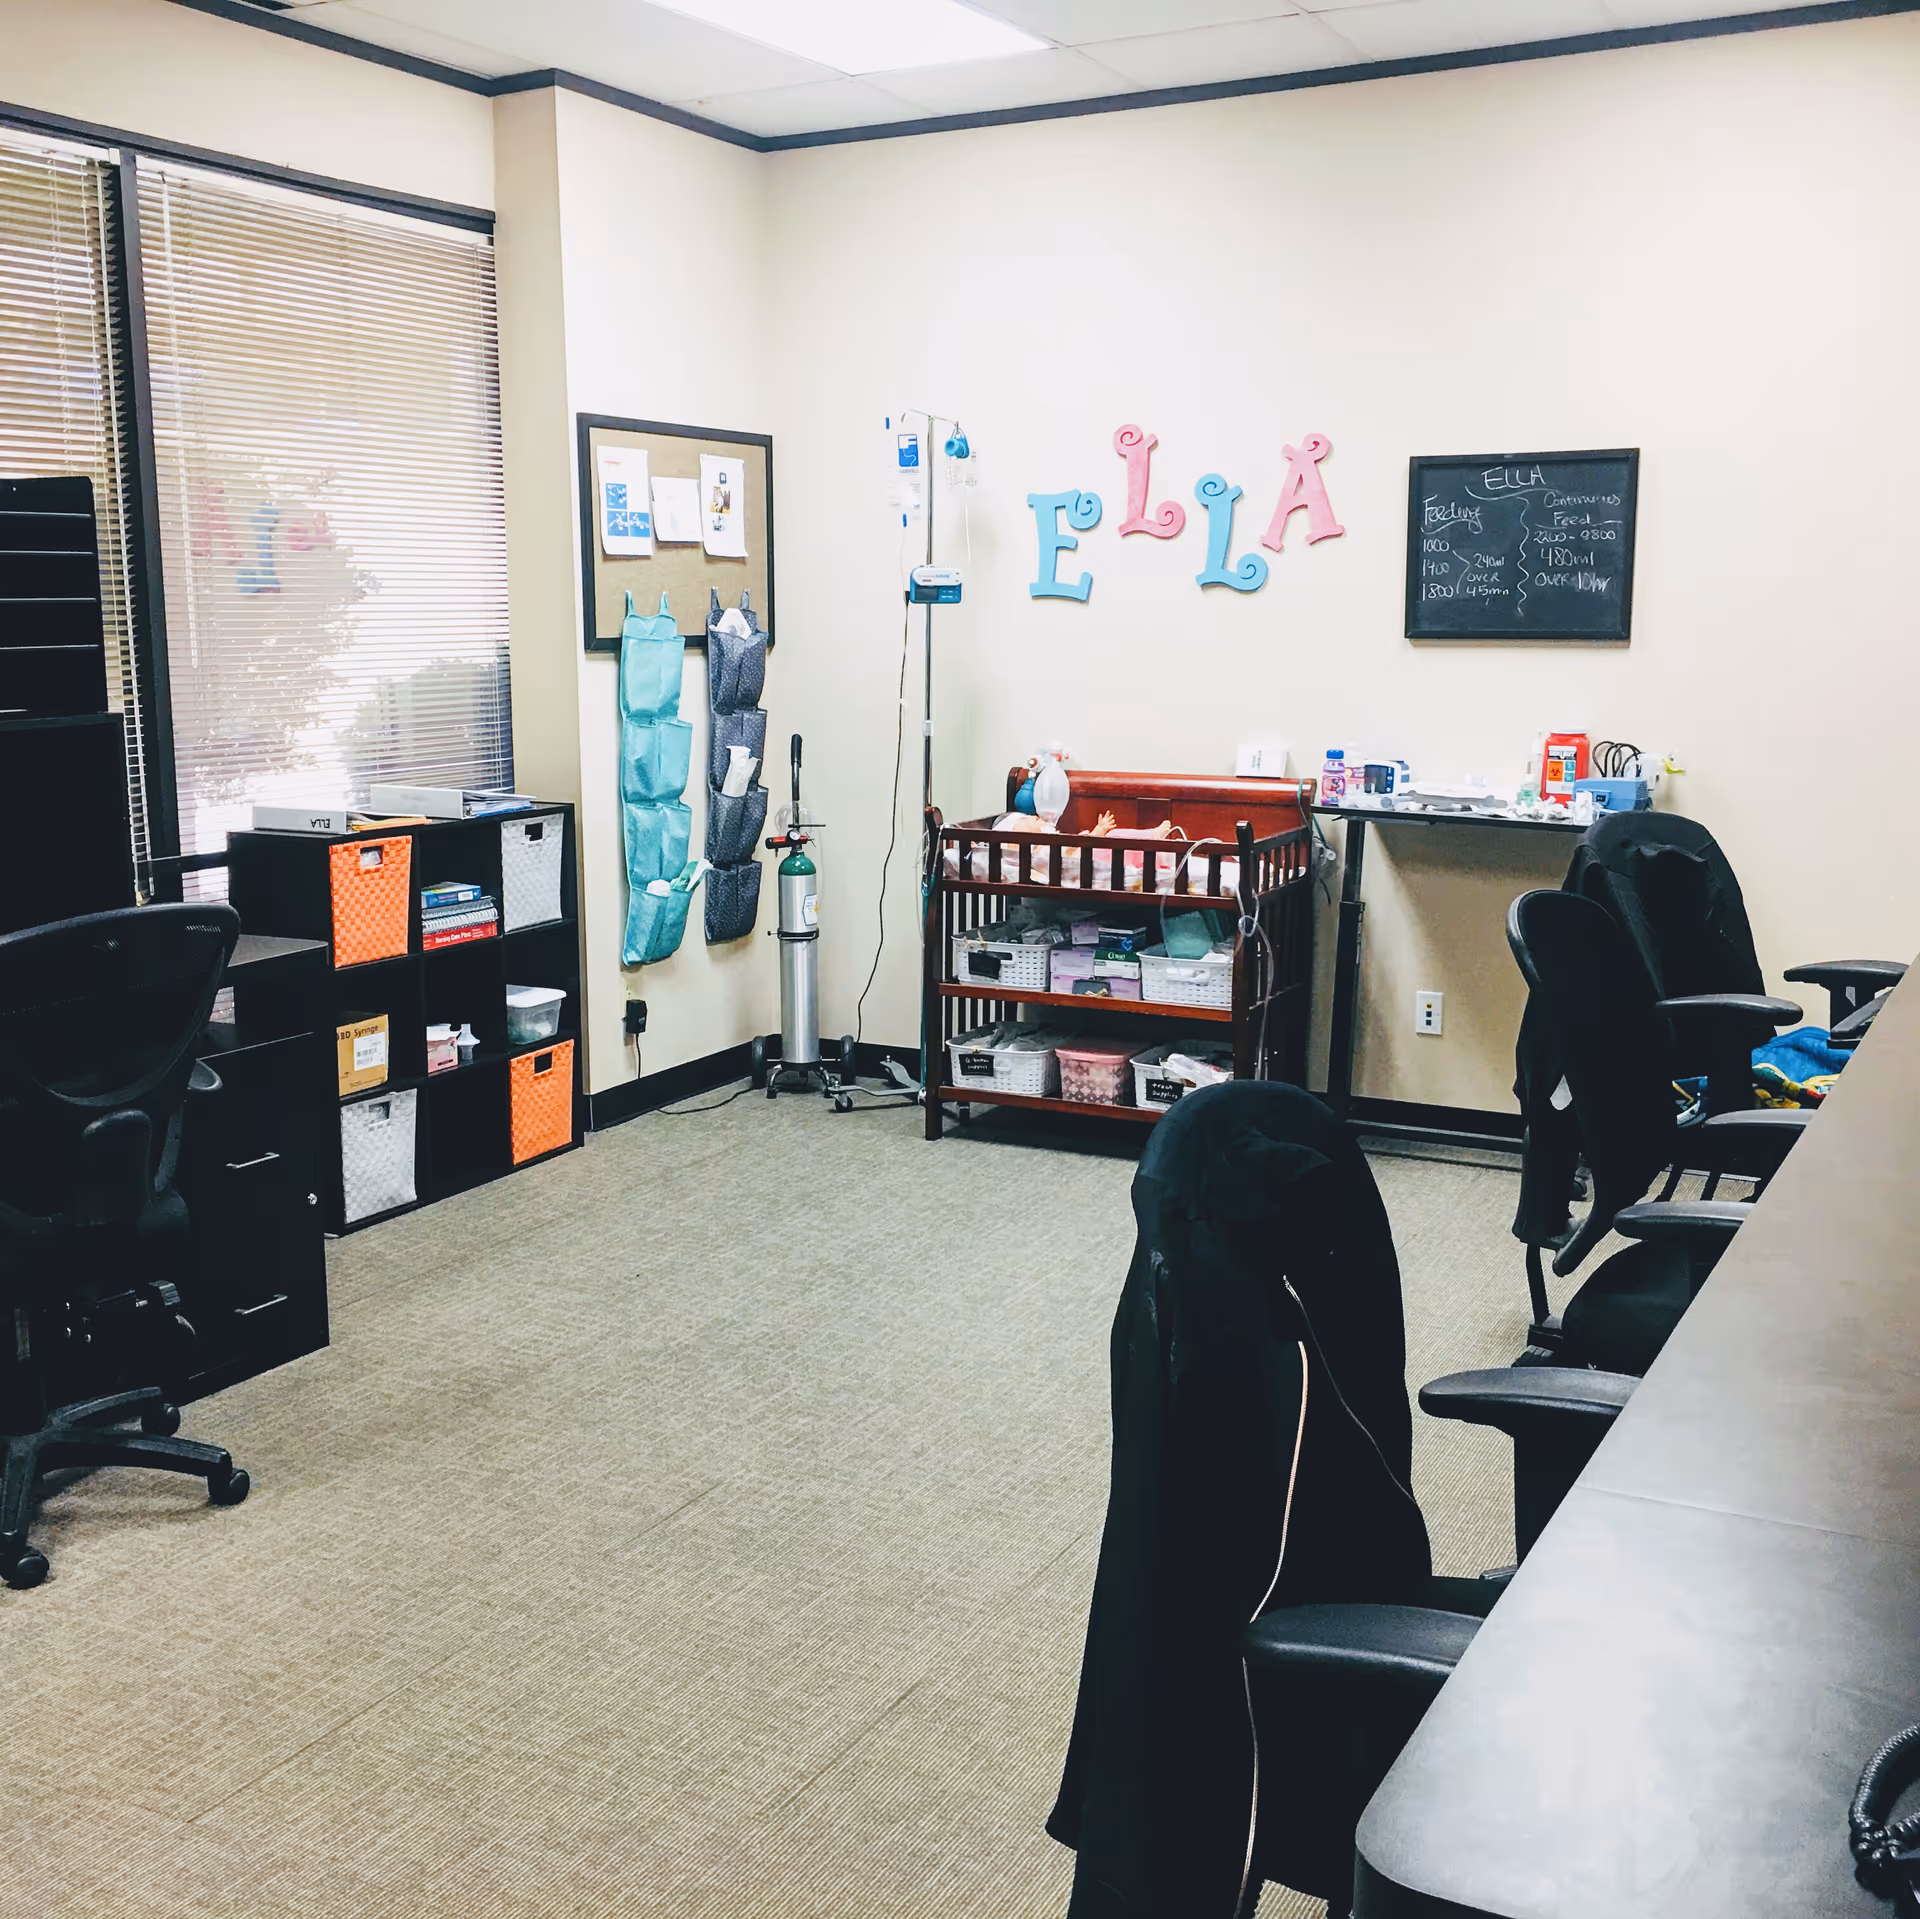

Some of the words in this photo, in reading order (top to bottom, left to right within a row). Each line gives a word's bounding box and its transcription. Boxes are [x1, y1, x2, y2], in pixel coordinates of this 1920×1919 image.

[1481, 464, 1546, 490] ELLA
[1027, 424, 1346, 602] ELLA
[1553, 511, 1591, 526] Feed
[1423, 538, 1450, 553] 1000
[1540, 546, 1594, 567] 480ml
[1422, 558, 1450, 577] 1400
[1422, 583, 1454, 602] 1800
[309, 818, 331, 829] ELLA
[340, 1030, 352, 1041] BD
[353, 1024, 379, 1038] Syringe
